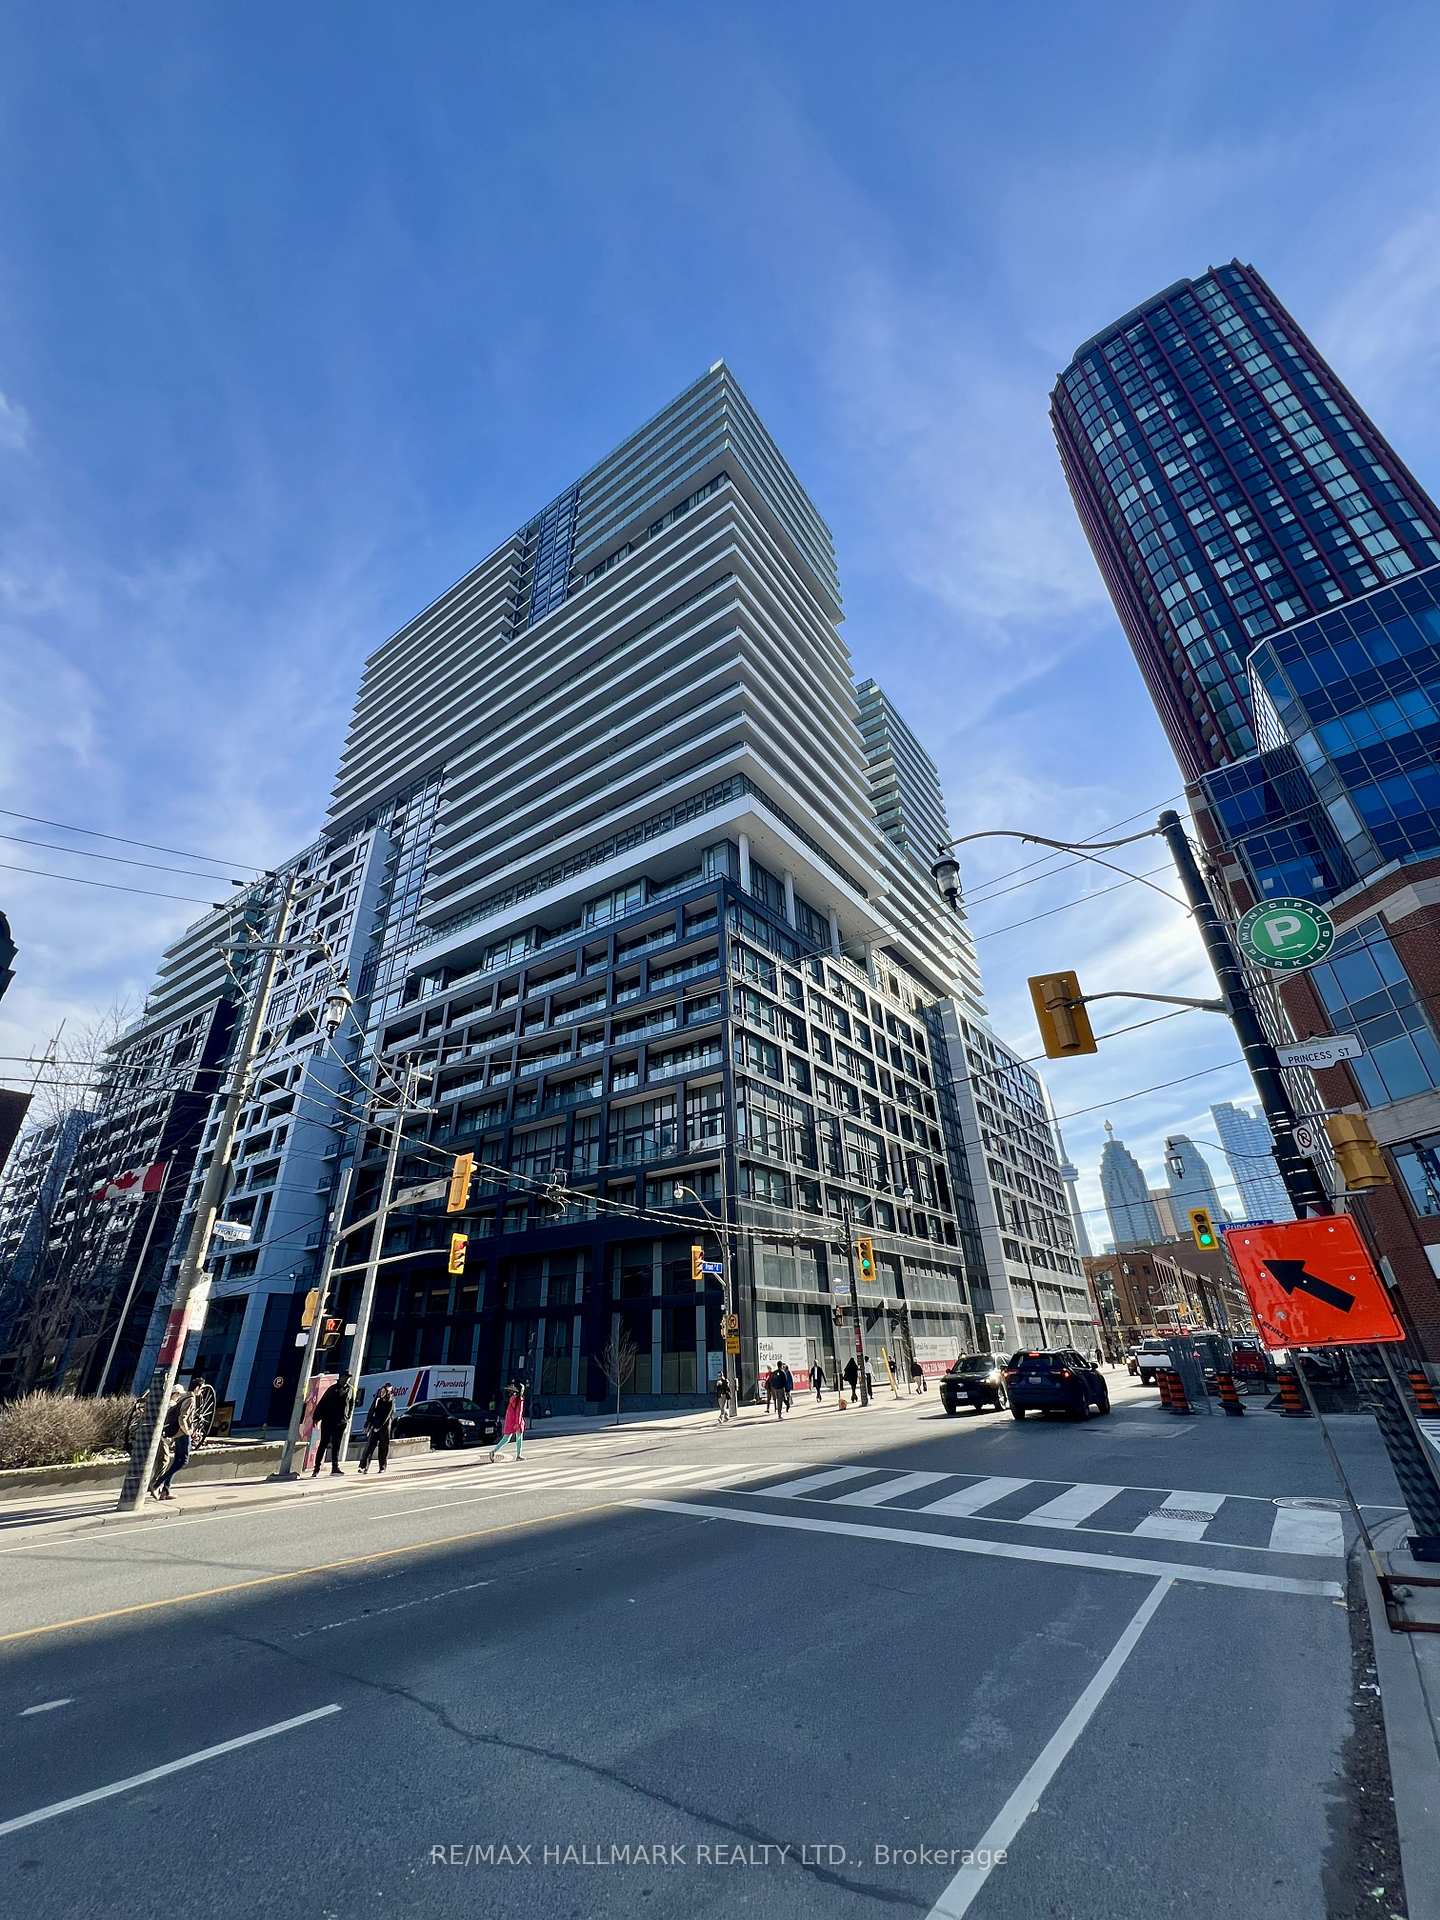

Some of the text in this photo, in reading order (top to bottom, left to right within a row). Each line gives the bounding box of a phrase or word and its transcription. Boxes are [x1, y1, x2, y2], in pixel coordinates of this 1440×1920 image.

[1242, 901, 1322, 940] MUNICIPAL
[1264, 915, 1301, 946] P
[1248, 931, 1330, 967] PARKING
[1288, 1048, 1350, 1064] PRINCESS ST
[759, 1342, 774, 1351] Retail
[759, 1352, 783, 1360] For Lease
